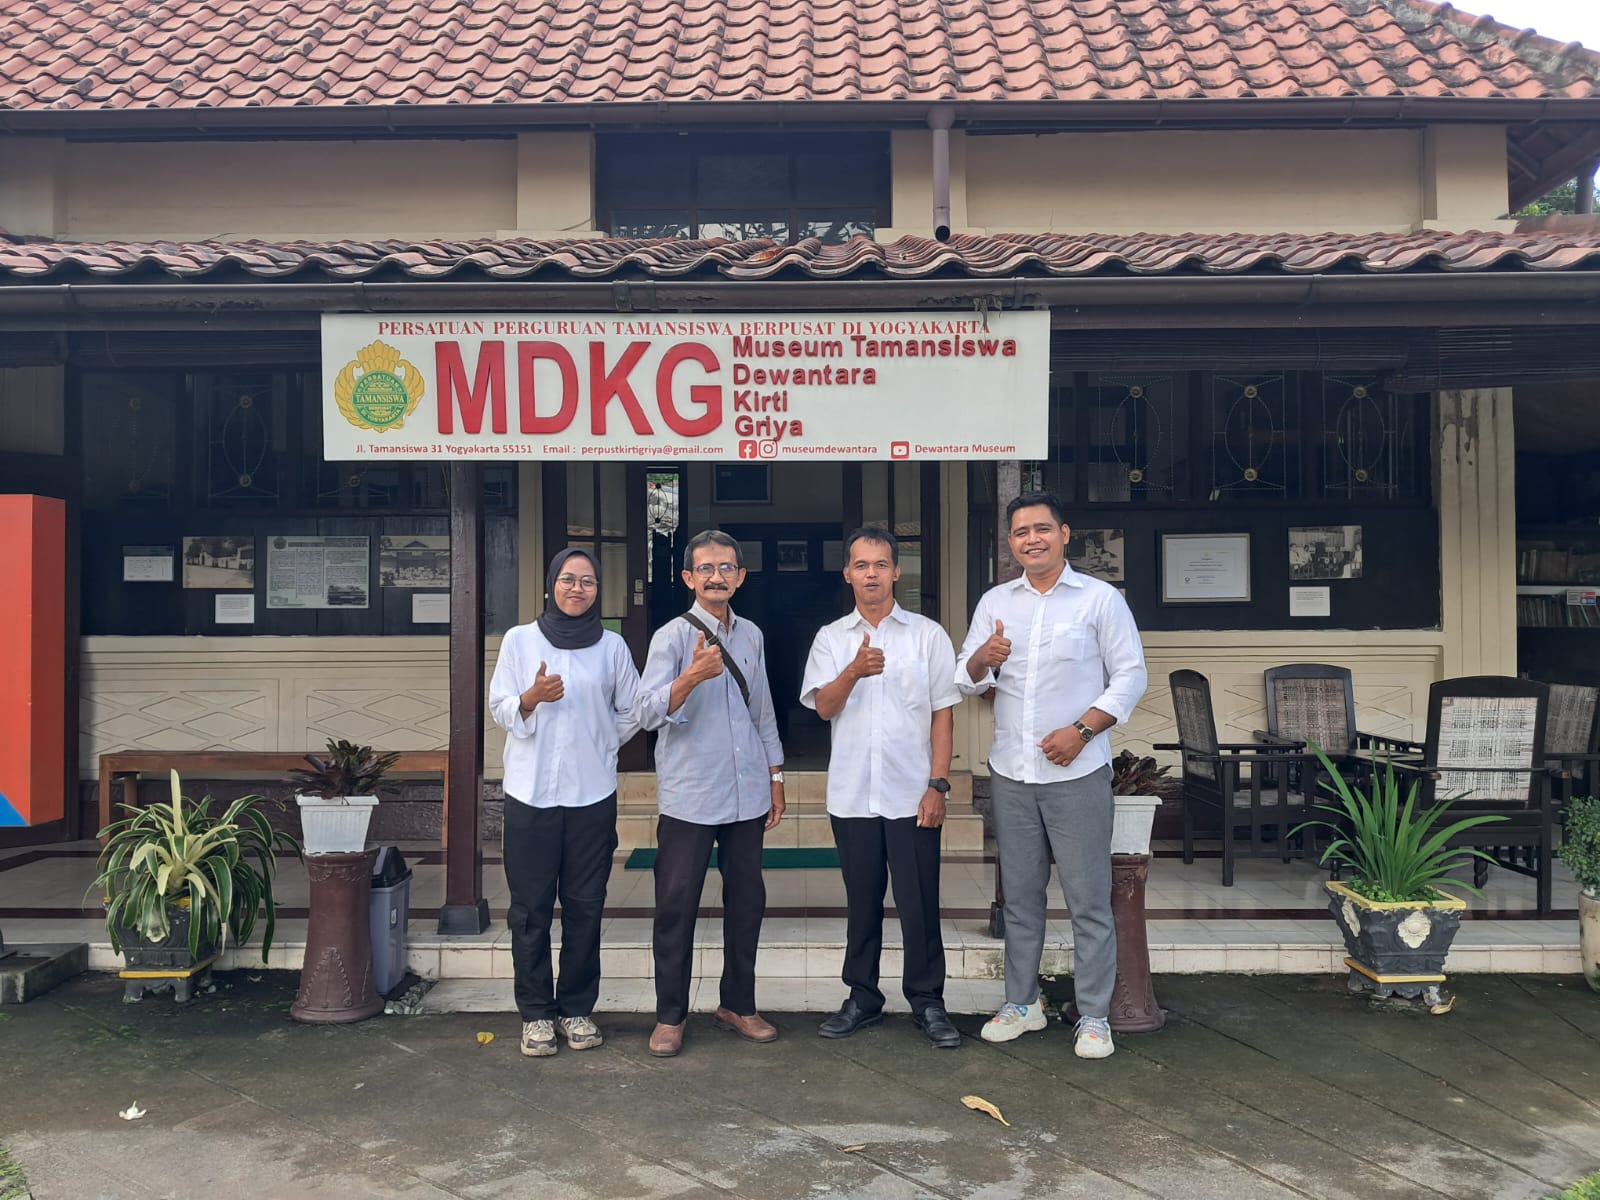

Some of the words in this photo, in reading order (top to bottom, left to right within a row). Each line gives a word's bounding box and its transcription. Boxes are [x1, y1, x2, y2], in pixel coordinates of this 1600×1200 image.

[378, 321, 484, 336] PERSATUAN
[493, 321, 607, 336] PERGURUAN
[613, 320, 733, 337] TAMANSISWA
[740, 320, 836, 336] BERPUSAT
[842, 320, 862, 336] DI
[869, 320, 990, 335] YOGYAKARTA
[733, 335, 843, 358] Museum
[851, 334, 1017, 357] Tamansiswa
[733, 363, 876, 386] Dewantara
[435, 340, 722, 437] MDKG
[355, 394, 405, 403] TAMANSISWA
[733, 390, 788, 413] Kirti
[734, 415, 803, 442] Griya
[356, 444, 366, 454] Jl.
[369, 444, 428, 454] Tamansiswa
[431, 444, 442, 454] 31
[446, 444, 500, 455] Yogyakarta
[502, 444, 532, 454] 55151
[543, 444, 570, 454] Email
[581, 444, 723, 456] perpustkirtigriya@gmail.com
[782, 444, 877, 454] museumdewantara
[915, 443, 969, 454] Dewantara
[972, 443, 1016, 454] Museum
